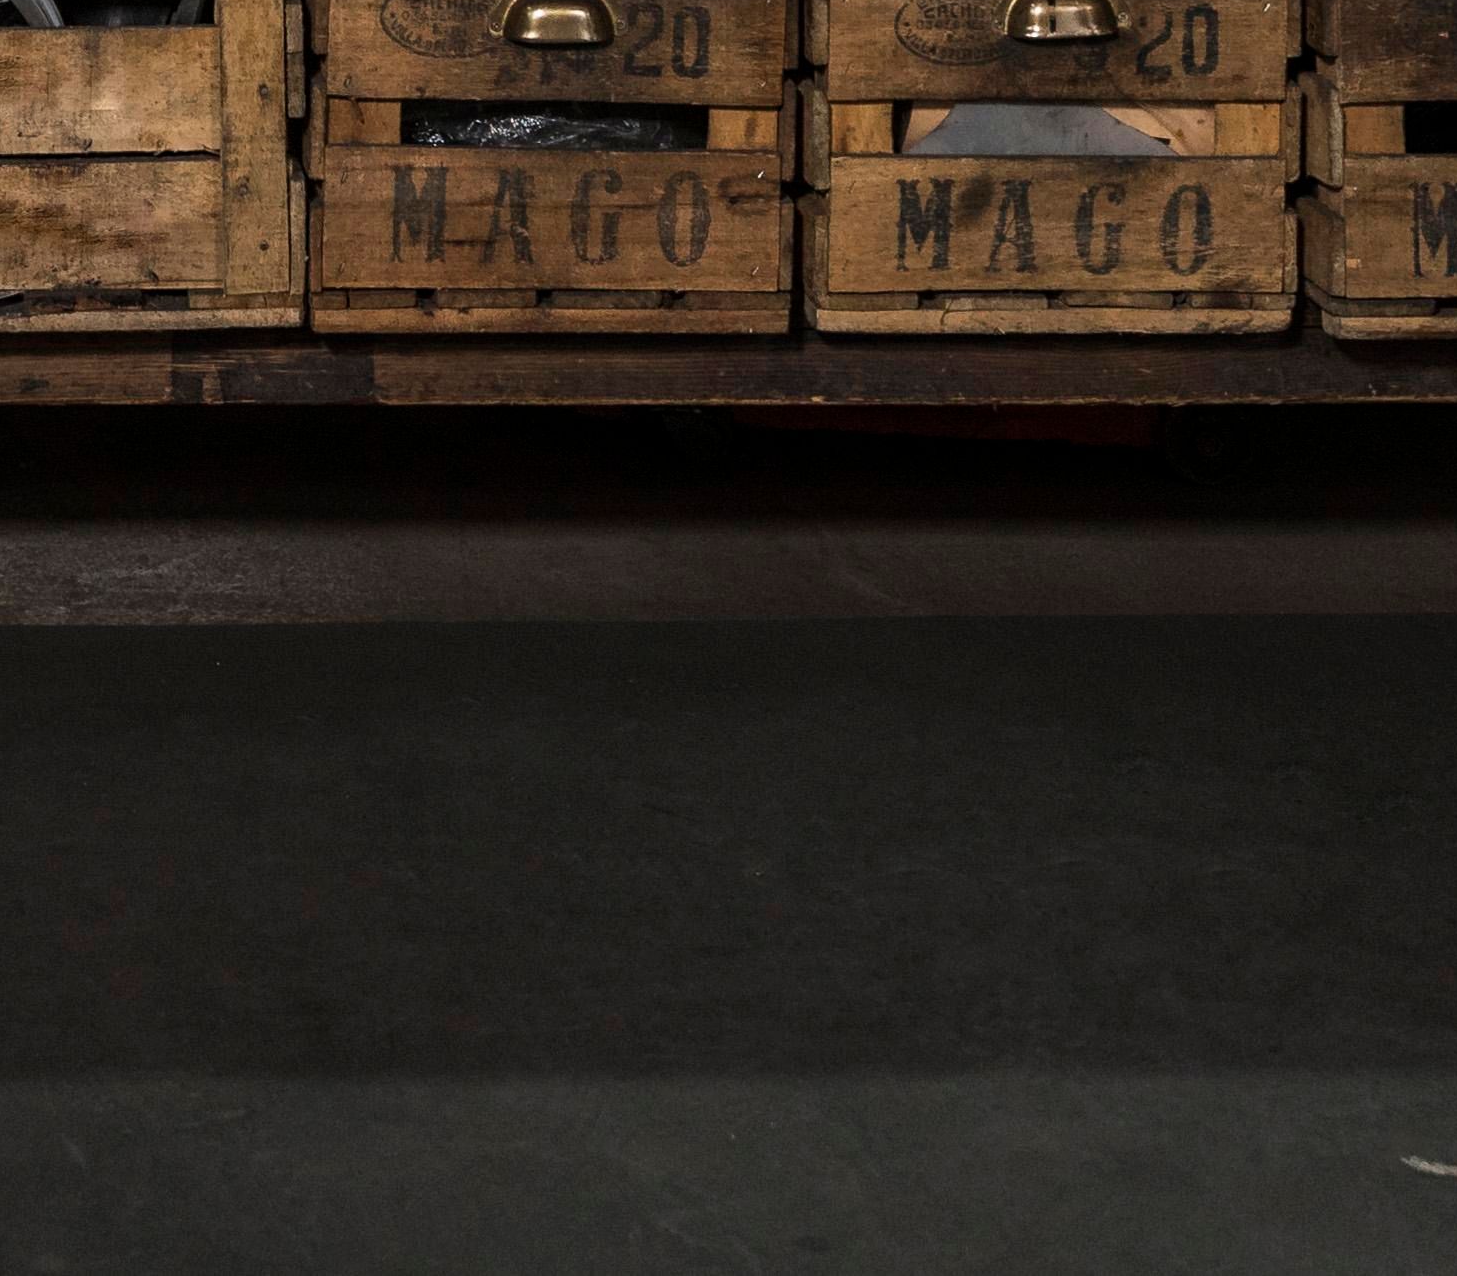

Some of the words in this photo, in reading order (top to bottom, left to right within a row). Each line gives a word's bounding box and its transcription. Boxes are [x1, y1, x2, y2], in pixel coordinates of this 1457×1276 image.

[621, 2, 711, 79] 20
[1136, 2, 1220, 77] 20
[389, 164, 712, 267] MAGO
[895, 177, 1215, 277] MAGO
